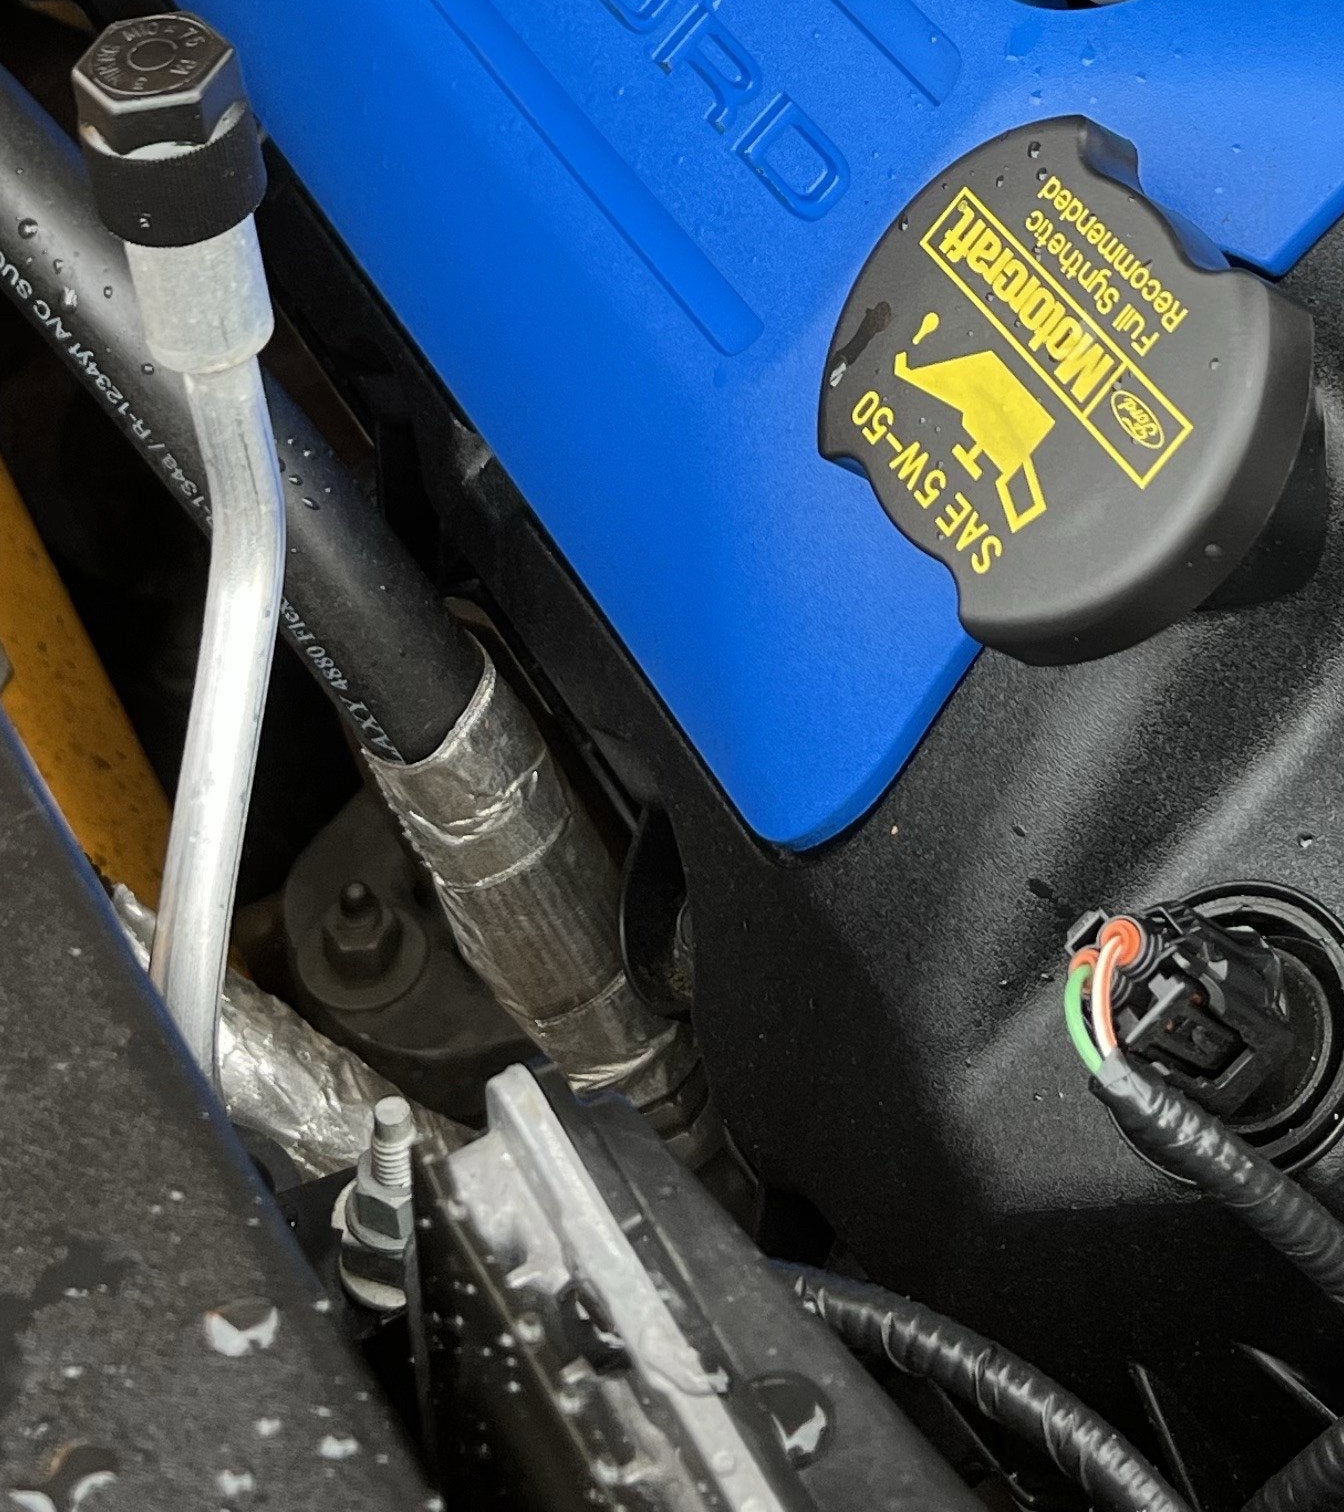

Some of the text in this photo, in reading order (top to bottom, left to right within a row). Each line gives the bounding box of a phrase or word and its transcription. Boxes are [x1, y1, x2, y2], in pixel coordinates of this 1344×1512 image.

[32, 299, 72, 340] A/C
[937, 204, 1159, 442] Ford Motorcraft
[1024, 209, 1160, 357] Full Synthetic
[1037, 175, 1189, 333] Recommended
[68, 342, 152, 439] R-1234yf
[851, 389, 1004, 576] SAE 5W-50
[306, 645, 348, 691] 4880
